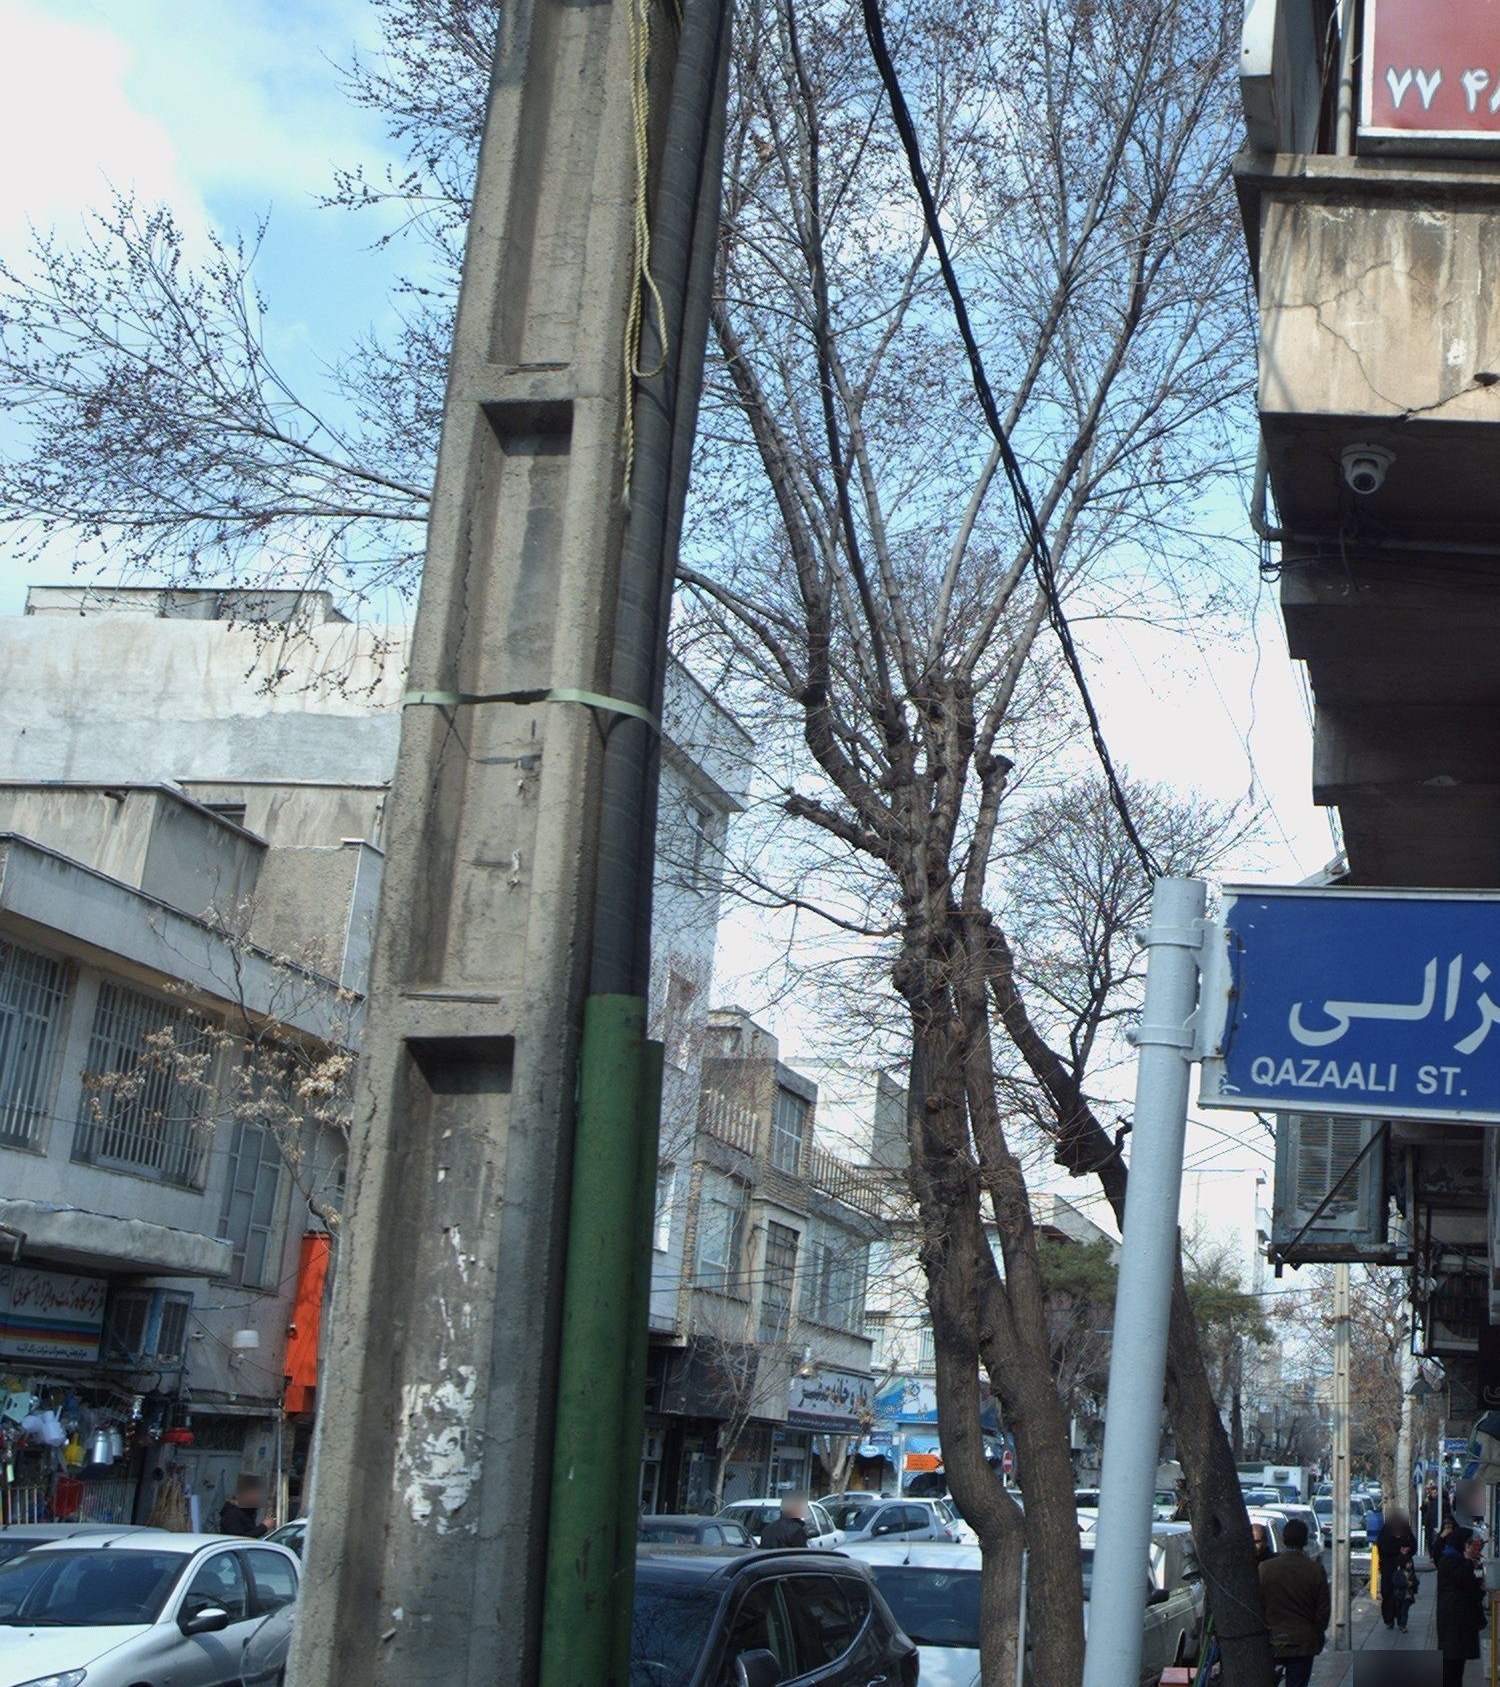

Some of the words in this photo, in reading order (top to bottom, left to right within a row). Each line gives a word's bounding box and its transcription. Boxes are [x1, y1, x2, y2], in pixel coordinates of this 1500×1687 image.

[1386, 66, 1443, 109] ۷۷
[1250, 1055, 1397, 1093] QAZAALI
[1415, 1065, 1468, 1096] ST.
